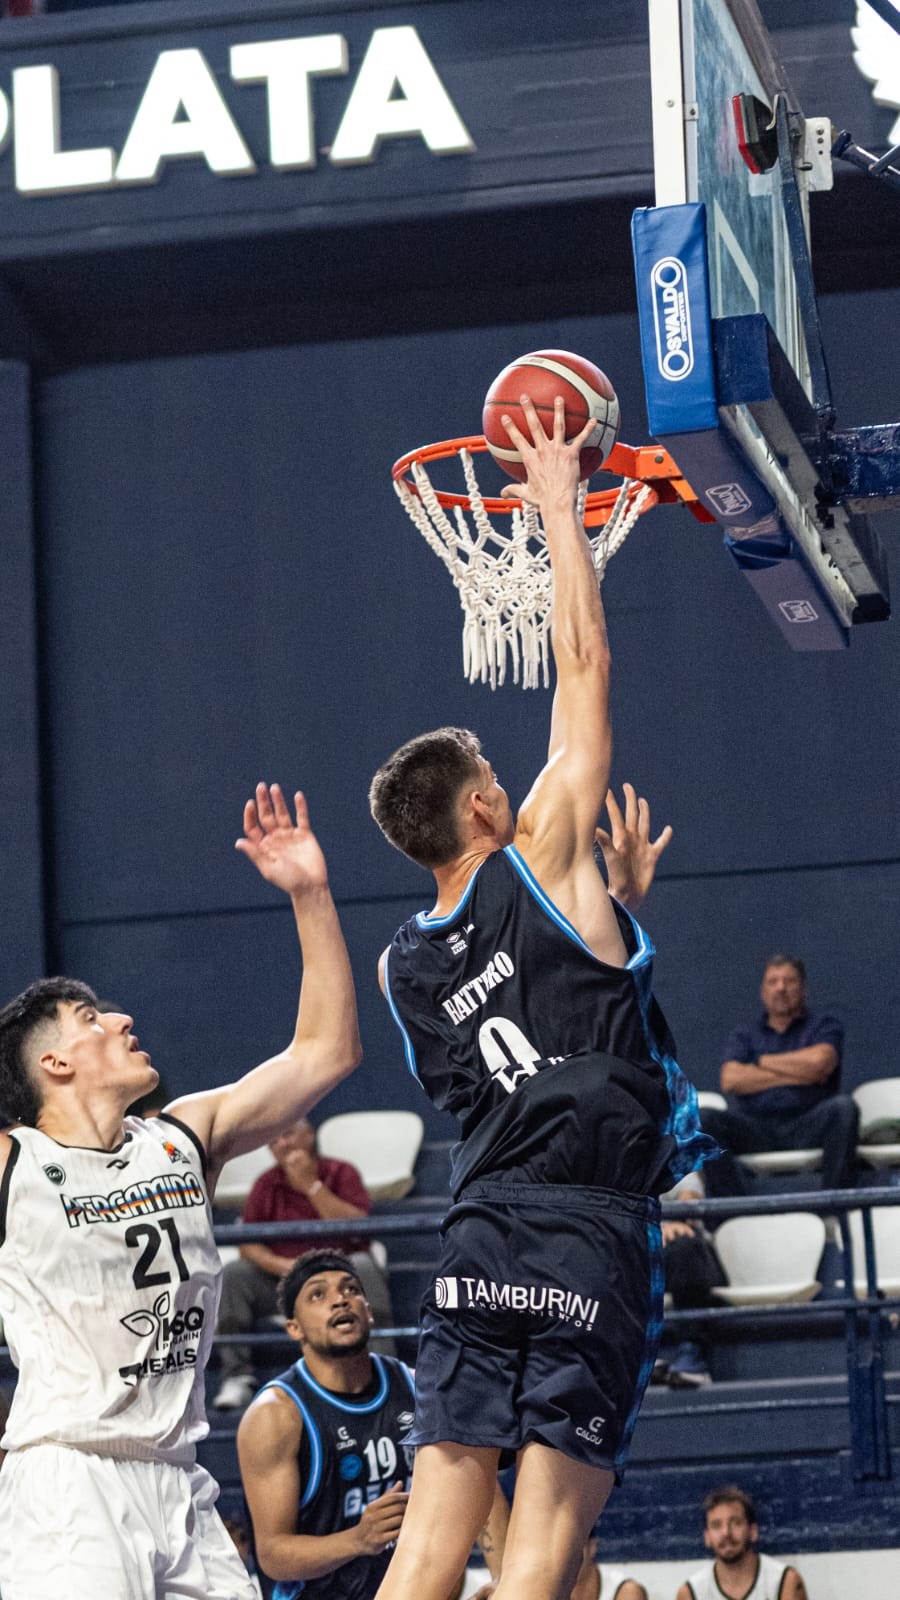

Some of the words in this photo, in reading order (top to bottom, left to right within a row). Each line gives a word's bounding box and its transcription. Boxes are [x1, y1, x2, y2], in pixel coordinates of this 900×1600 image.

[0, 26, 476, 194] LATA
[655, 261, 690, 377] OSVALDO
[61, 1172, 205, 1228] PERGAMINO
[125, 1217, 190, 1290] 21
[461, 1277, 599, 1324] TAMBURINI
[363, 1436, 397, 1482] 19
